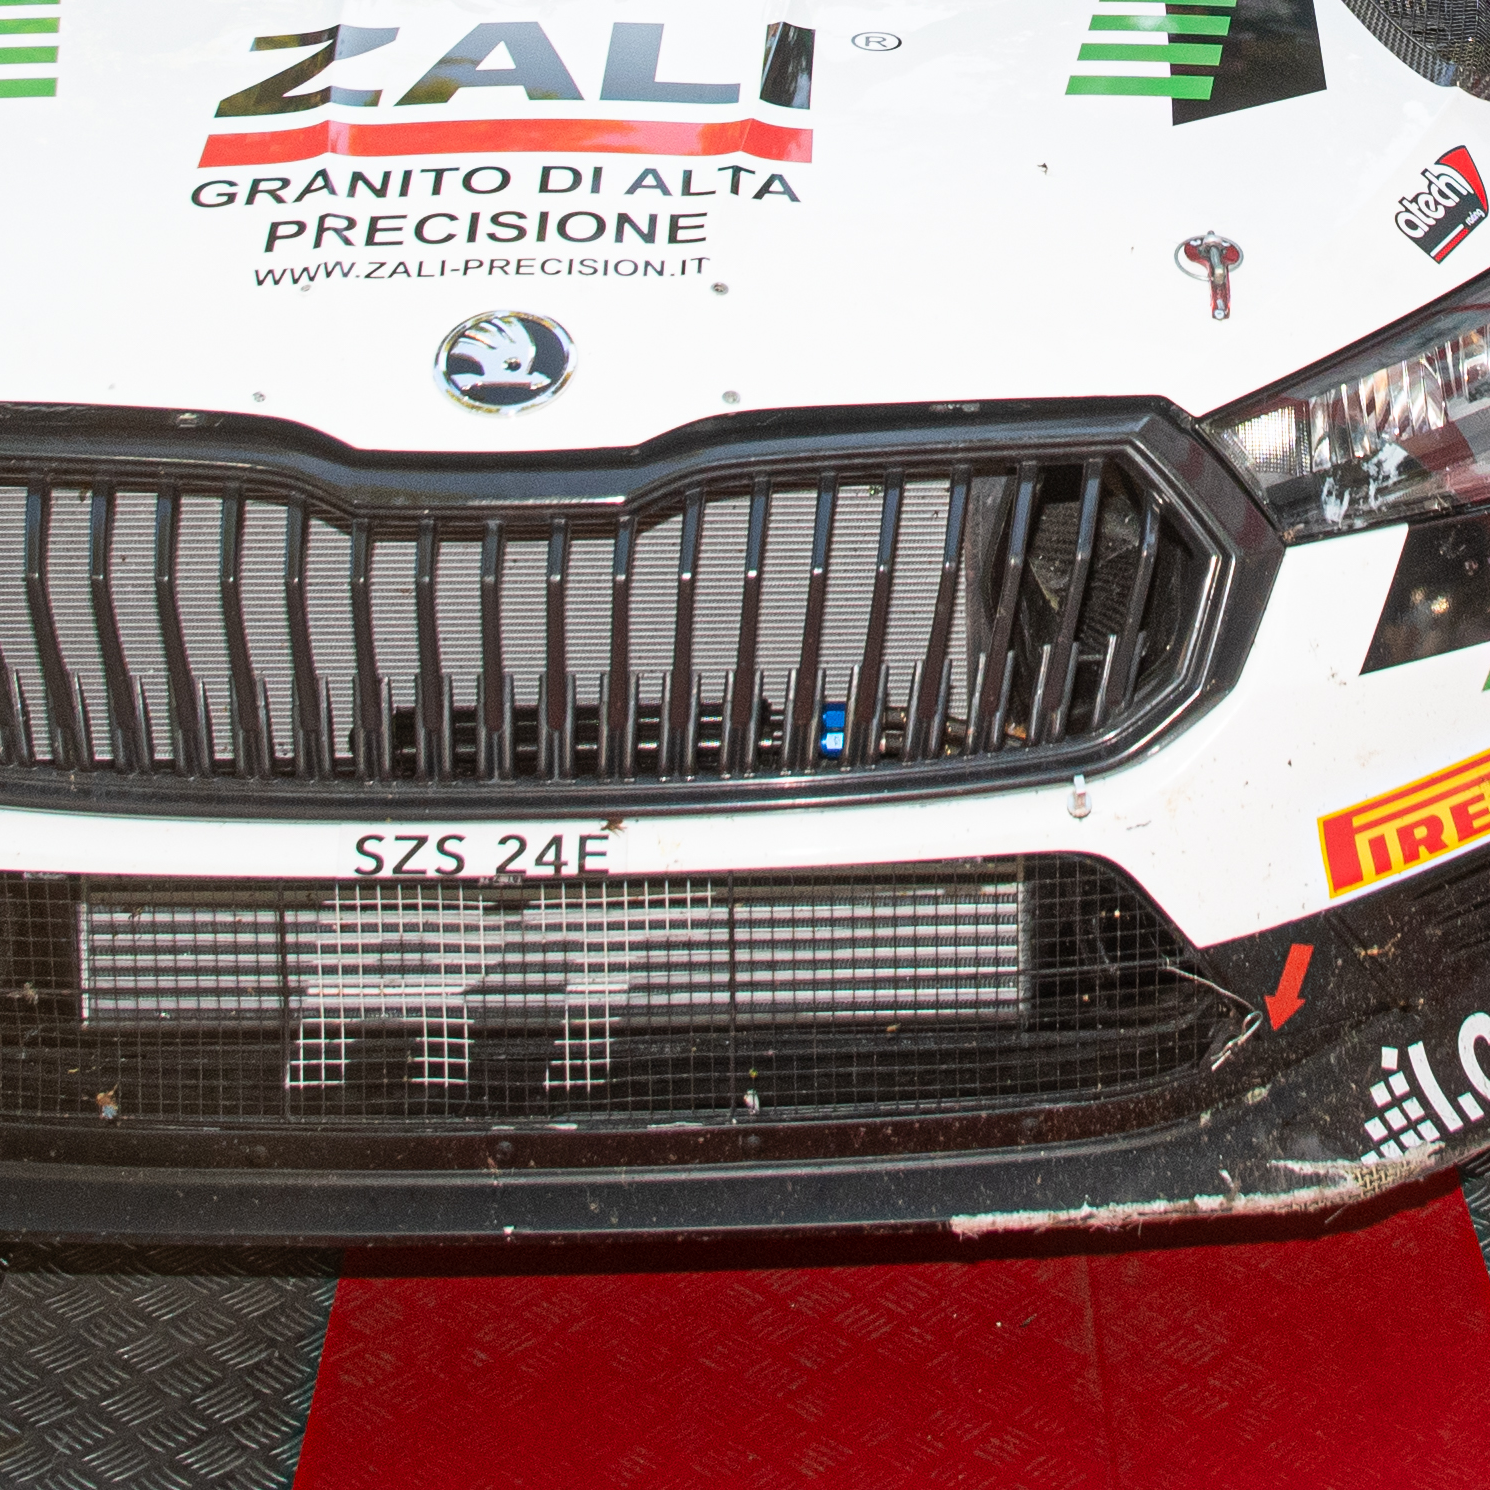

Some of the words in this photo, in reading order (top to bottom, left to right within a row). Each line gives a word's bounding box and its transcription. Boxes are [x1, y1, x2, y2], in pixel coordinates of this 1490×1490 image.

[214, 20, 816, 118] ZALI
[190, 165, 513, 208] GRANITO
[538, 164, 605, 196] DI
[624, 164, 802, 204] ALTA
[1396, 165, 1473, 239] atech
[263, 210, 709, 254] PRECISIONE
[1466, 207, 1487, 228] racing
[253, 255, 712, 287] WWW.ZALI-PRECISION.IT
[354, 833, 465, 876] SZS
[497, 833, 610, 876] 24E
